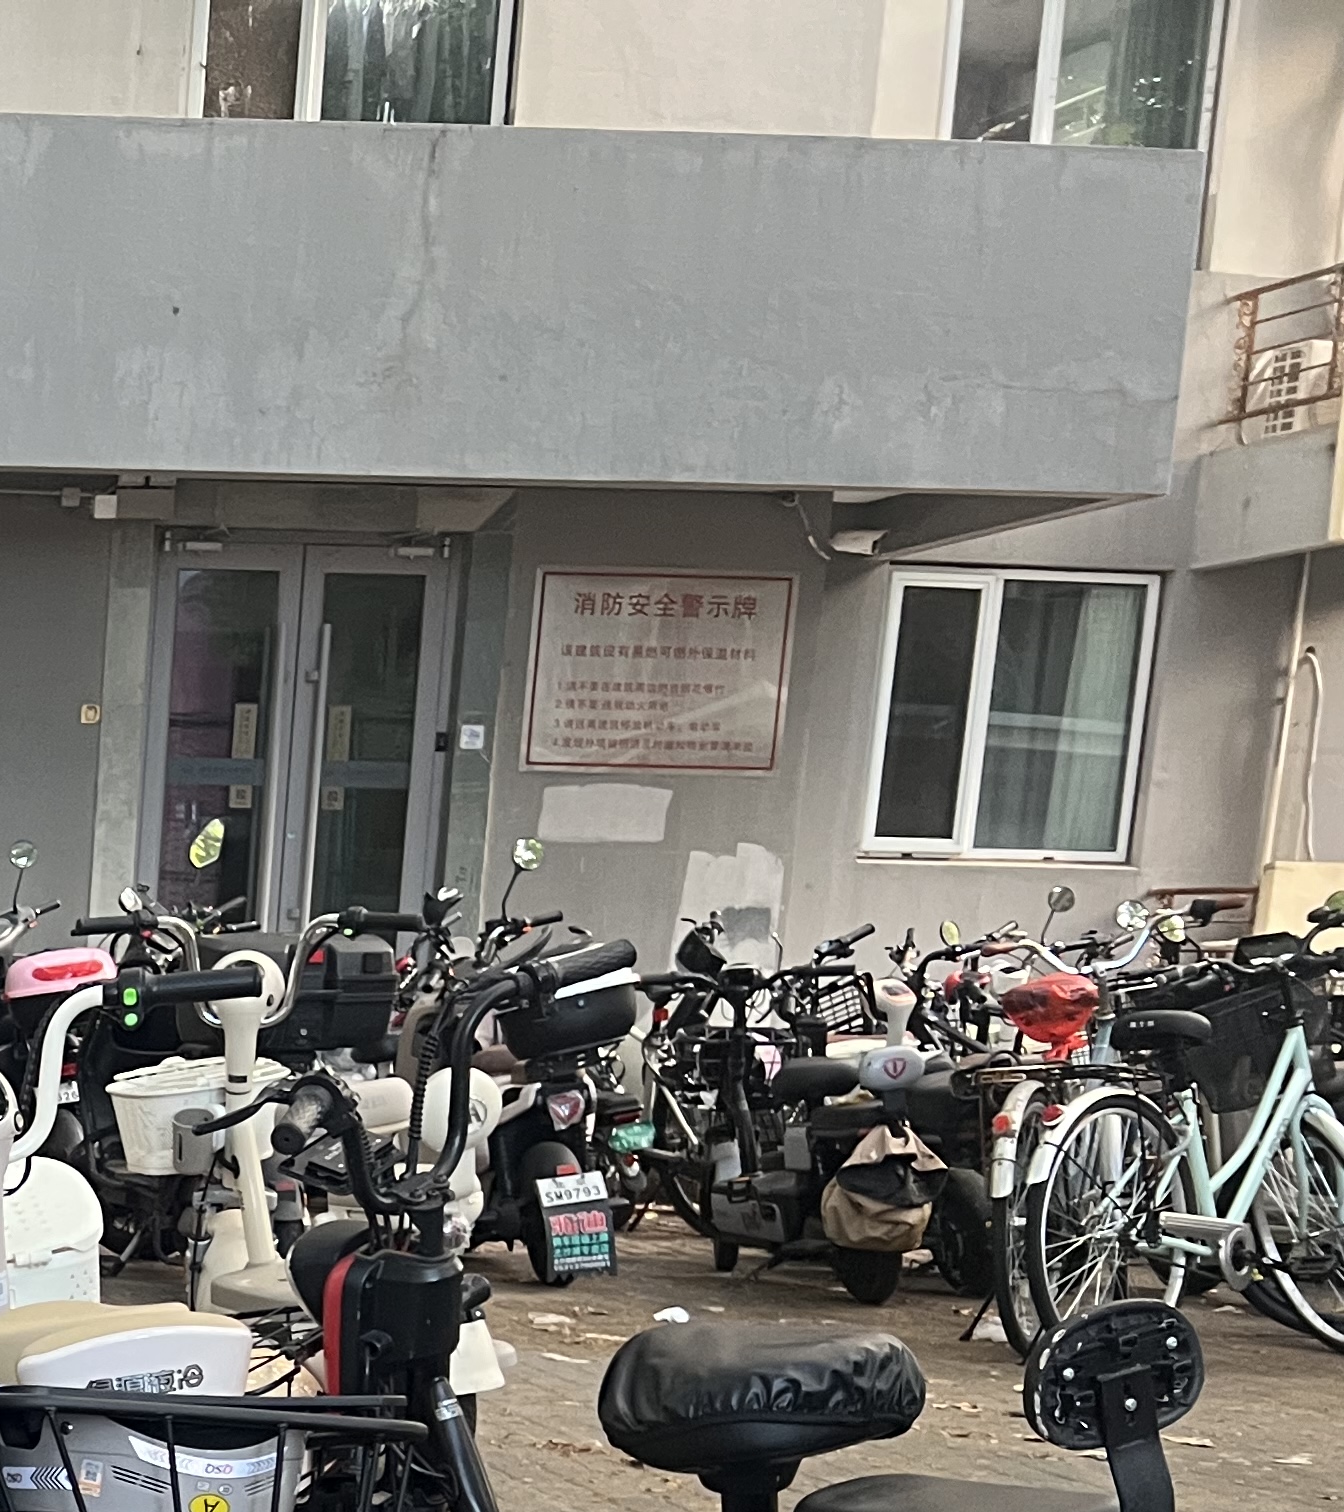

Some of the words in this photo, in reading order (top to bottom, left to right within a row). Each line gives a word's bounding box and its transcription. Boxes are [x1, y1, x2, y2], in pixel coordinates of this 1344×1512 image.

[574, 592, 758, 620] 消防安全警示牌
